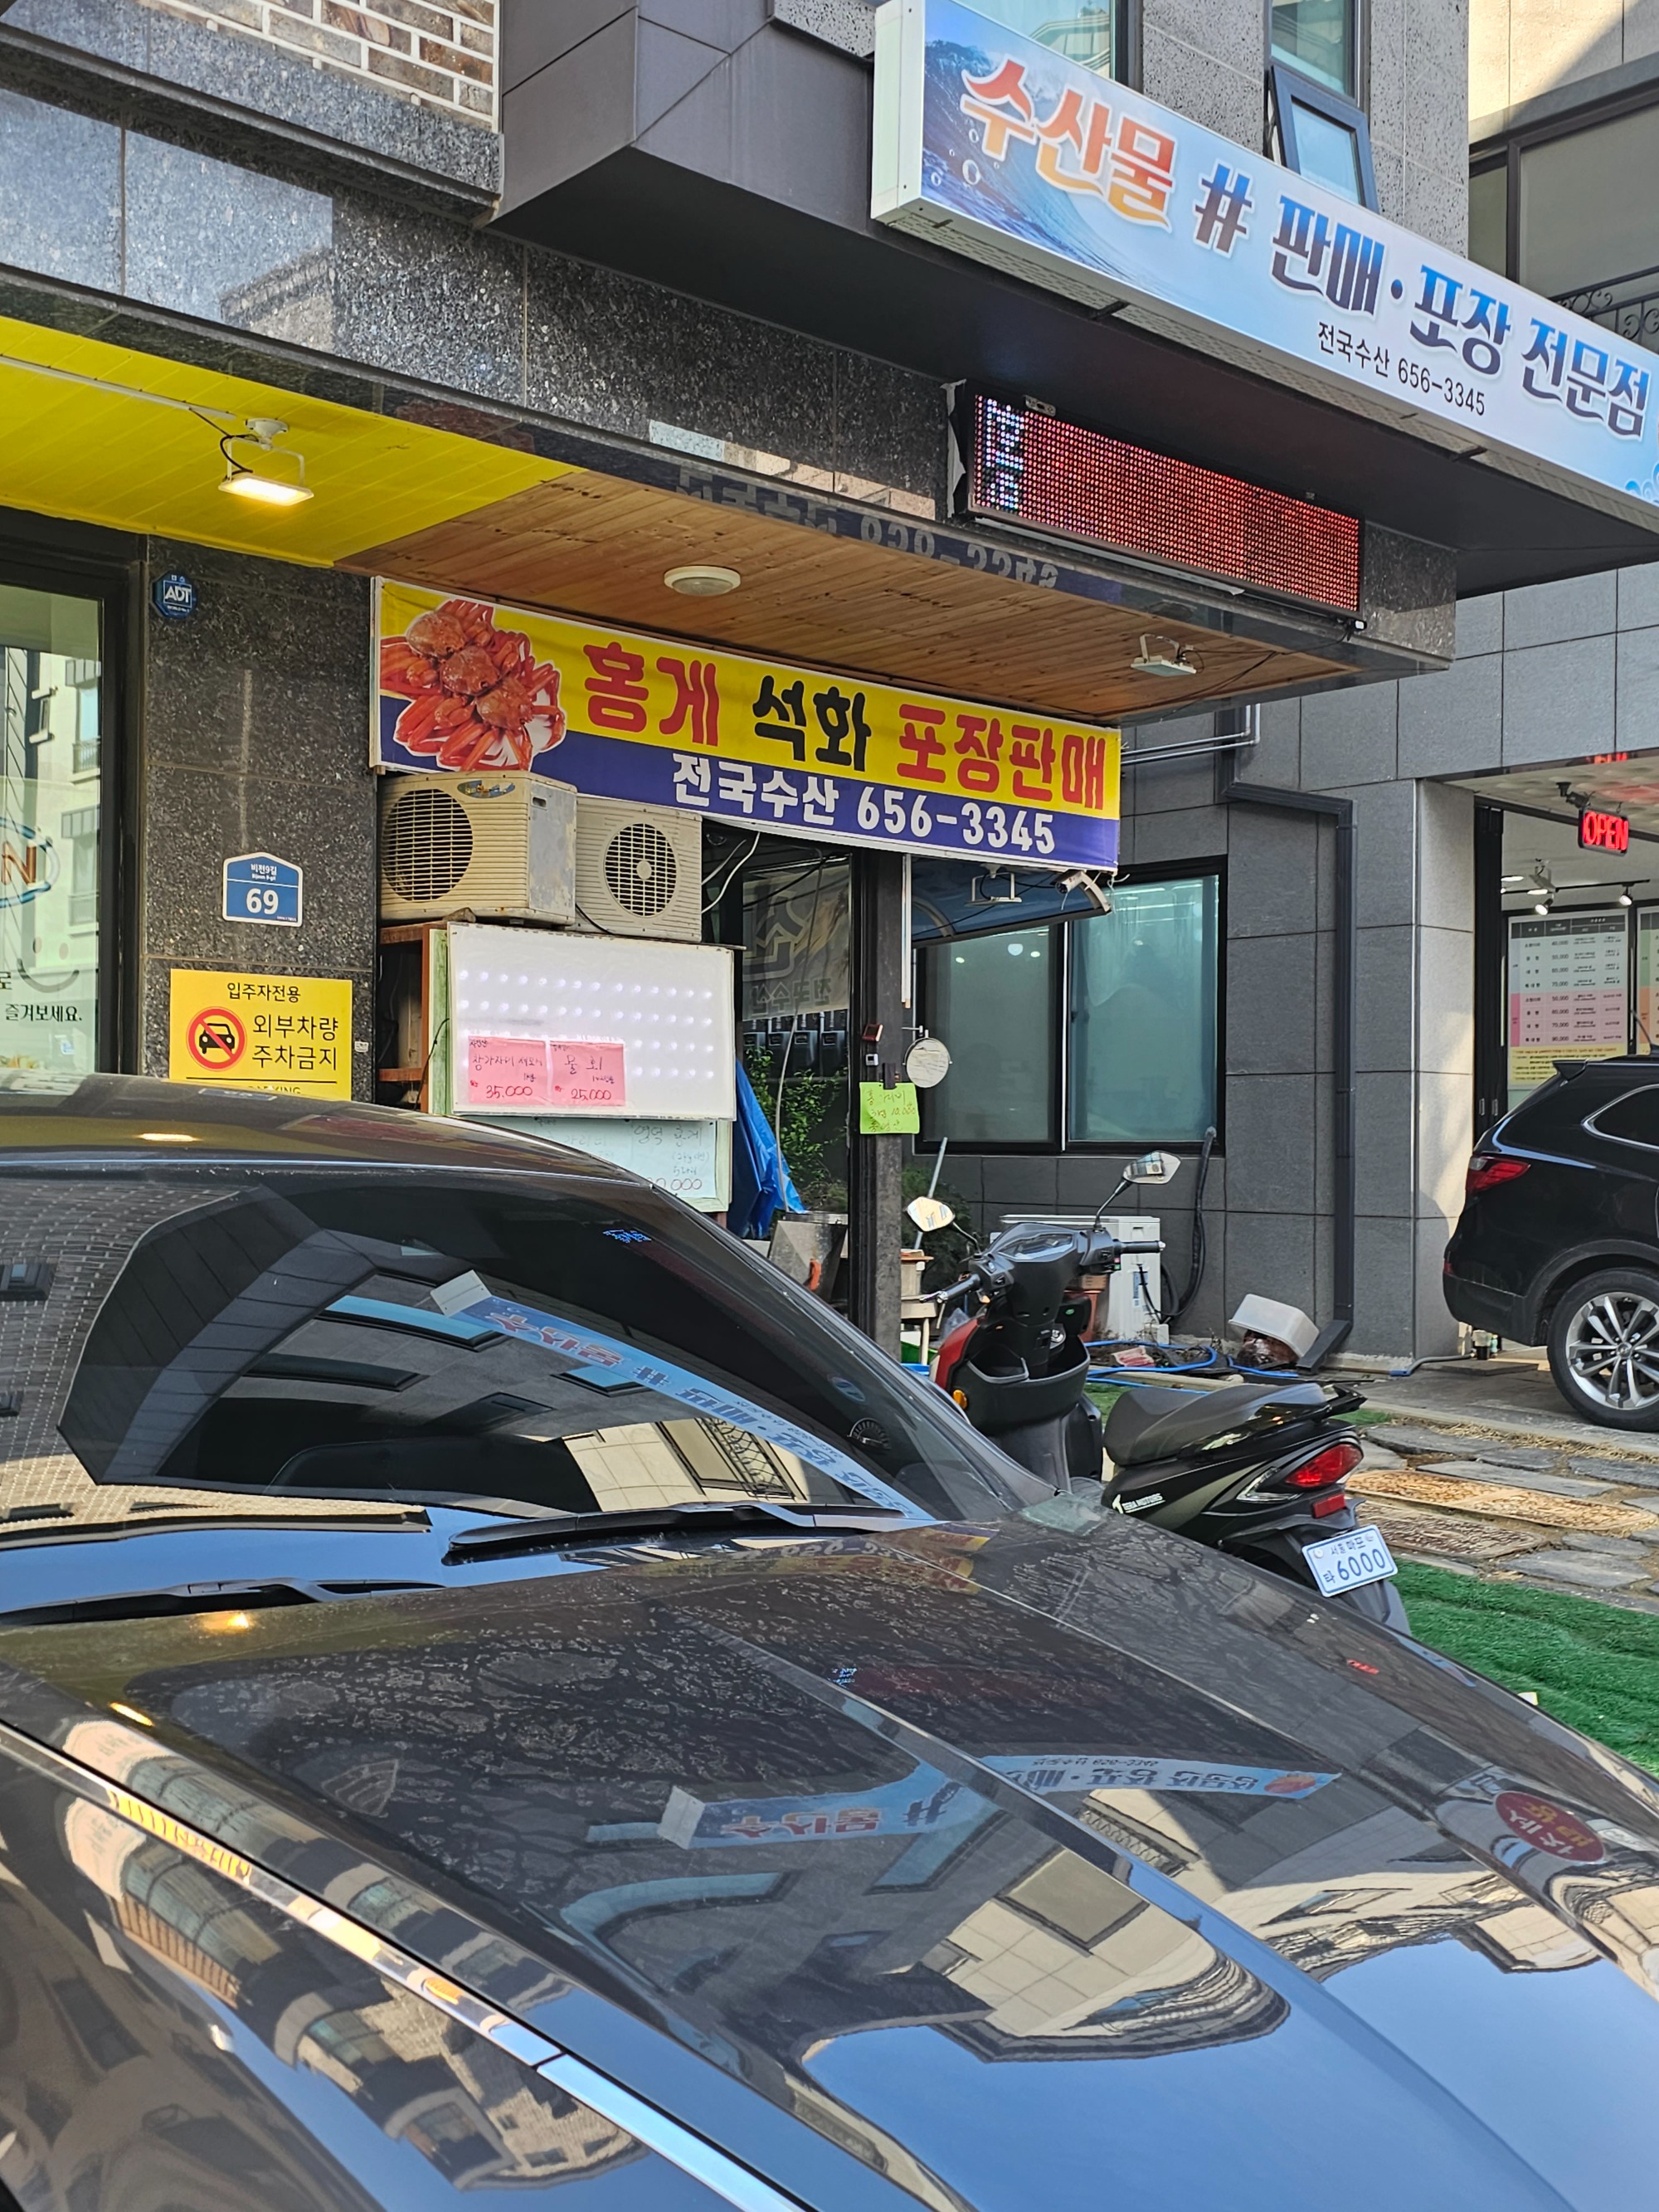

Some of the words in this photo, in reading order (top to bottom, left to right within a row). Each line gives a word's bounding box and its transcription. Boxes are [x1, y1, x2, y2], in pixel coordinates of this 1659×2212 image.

[961, 58, 1176, 233] 수산물
[1522, 318, 1651, 441] 전문점
[1317, 321, 1390, 378] 전국수산
[1398, 358, 1486, 416] 656-3345
[165, 585, 192, 603] ADT
[583, 641, 720, 747] 홍게
[752, 675, 872, 772] 석화
[897, 704, 1107, 811] 포장판매
[673, 753, 839, 826] 전국수산
[857, 787, 1055, 855] 656-3345
[1583, 811, 1628, 851] OPEN
[246, 888, 279, 914] 69
[227, 982, 301, 1003] 입주자전용
[6, 1003, 82, 1022] 즐겨보세요.
[252, 1014, 338, 1041] 외부차량
[252, 1045, 338, 1071] 주차금지
[1336, 1548, 1386, 1581] 6000
